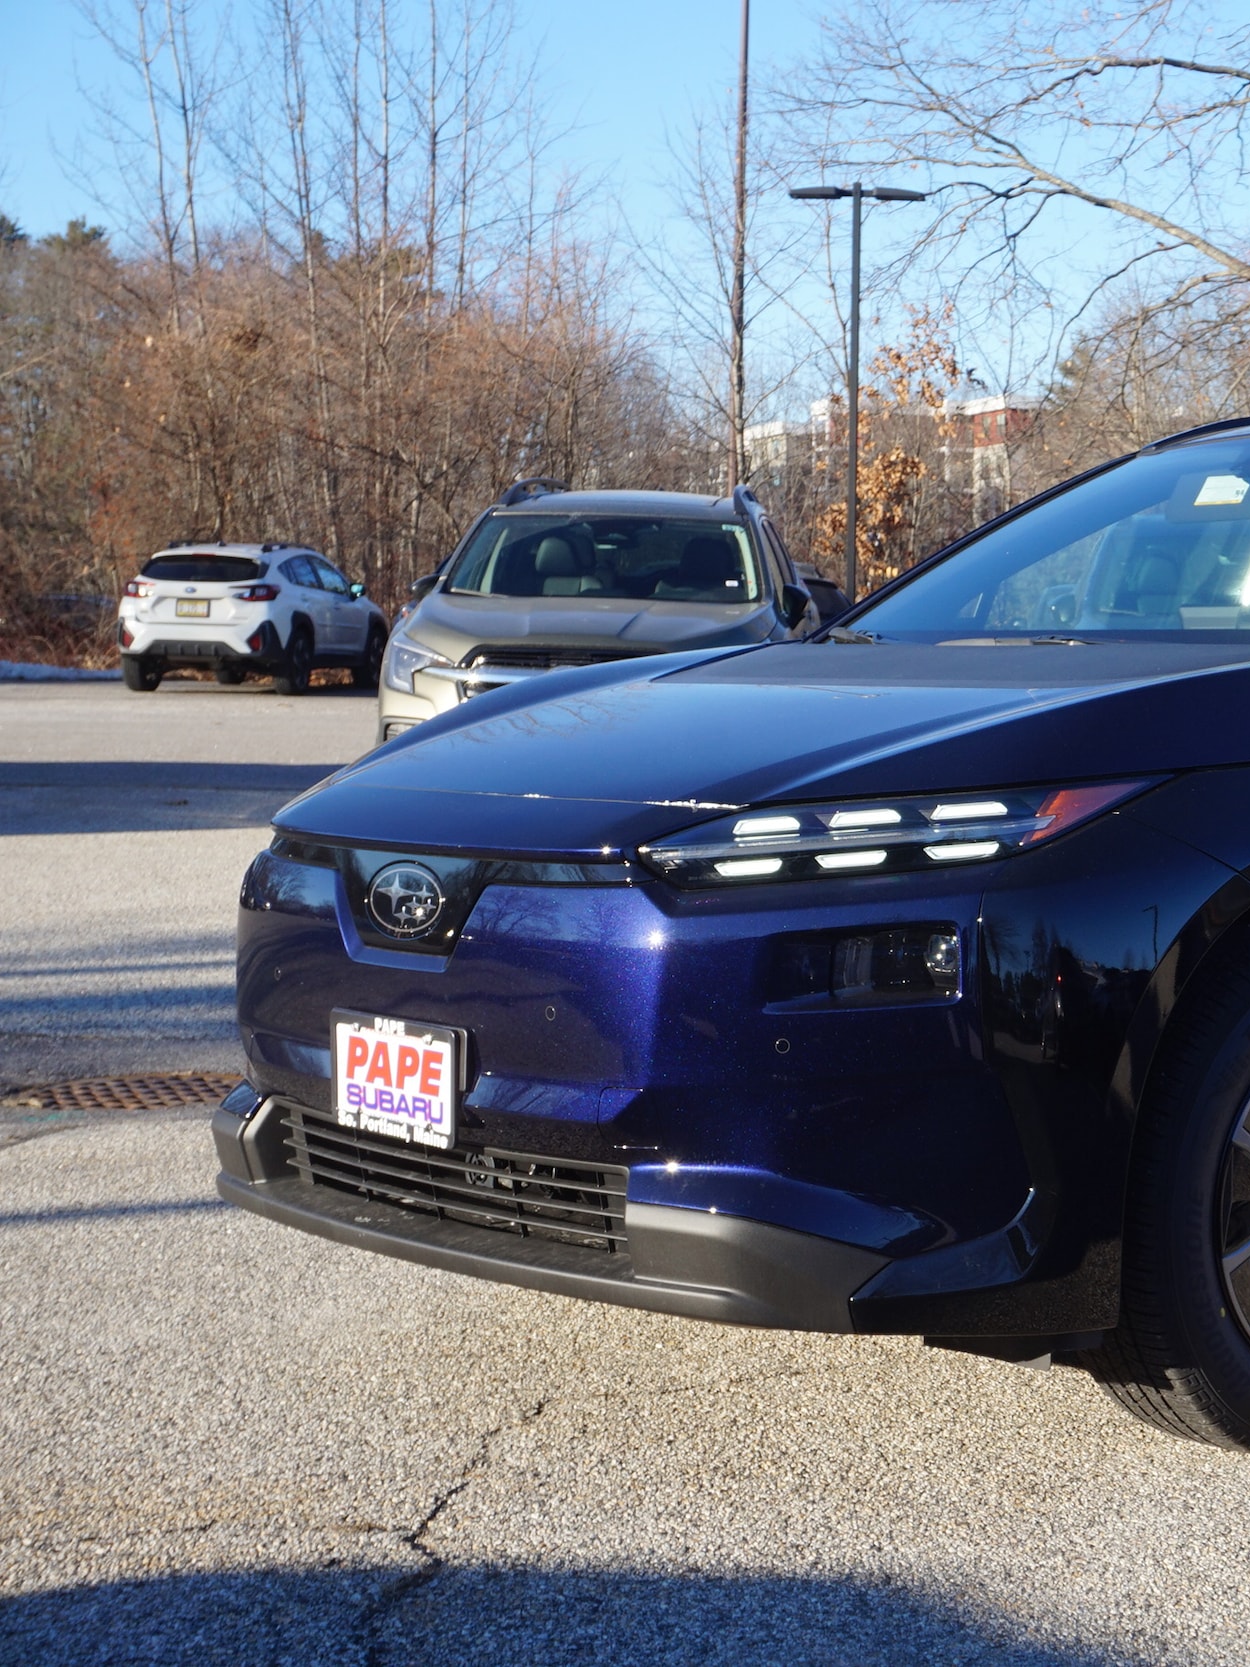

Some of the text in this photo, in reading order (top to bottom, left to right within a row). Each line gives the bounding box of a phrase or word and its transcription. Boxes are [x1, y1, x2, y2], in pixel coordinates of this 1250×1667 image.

[374, 1016, 406, 1036] PAPE
[346, 1035, 444, 1097] PAPE
[346, 1082, 444, 1125] SUBARU
[360, 1113, 411, 1144] Portland,
[413, 1125, 449, 1150] Maine
